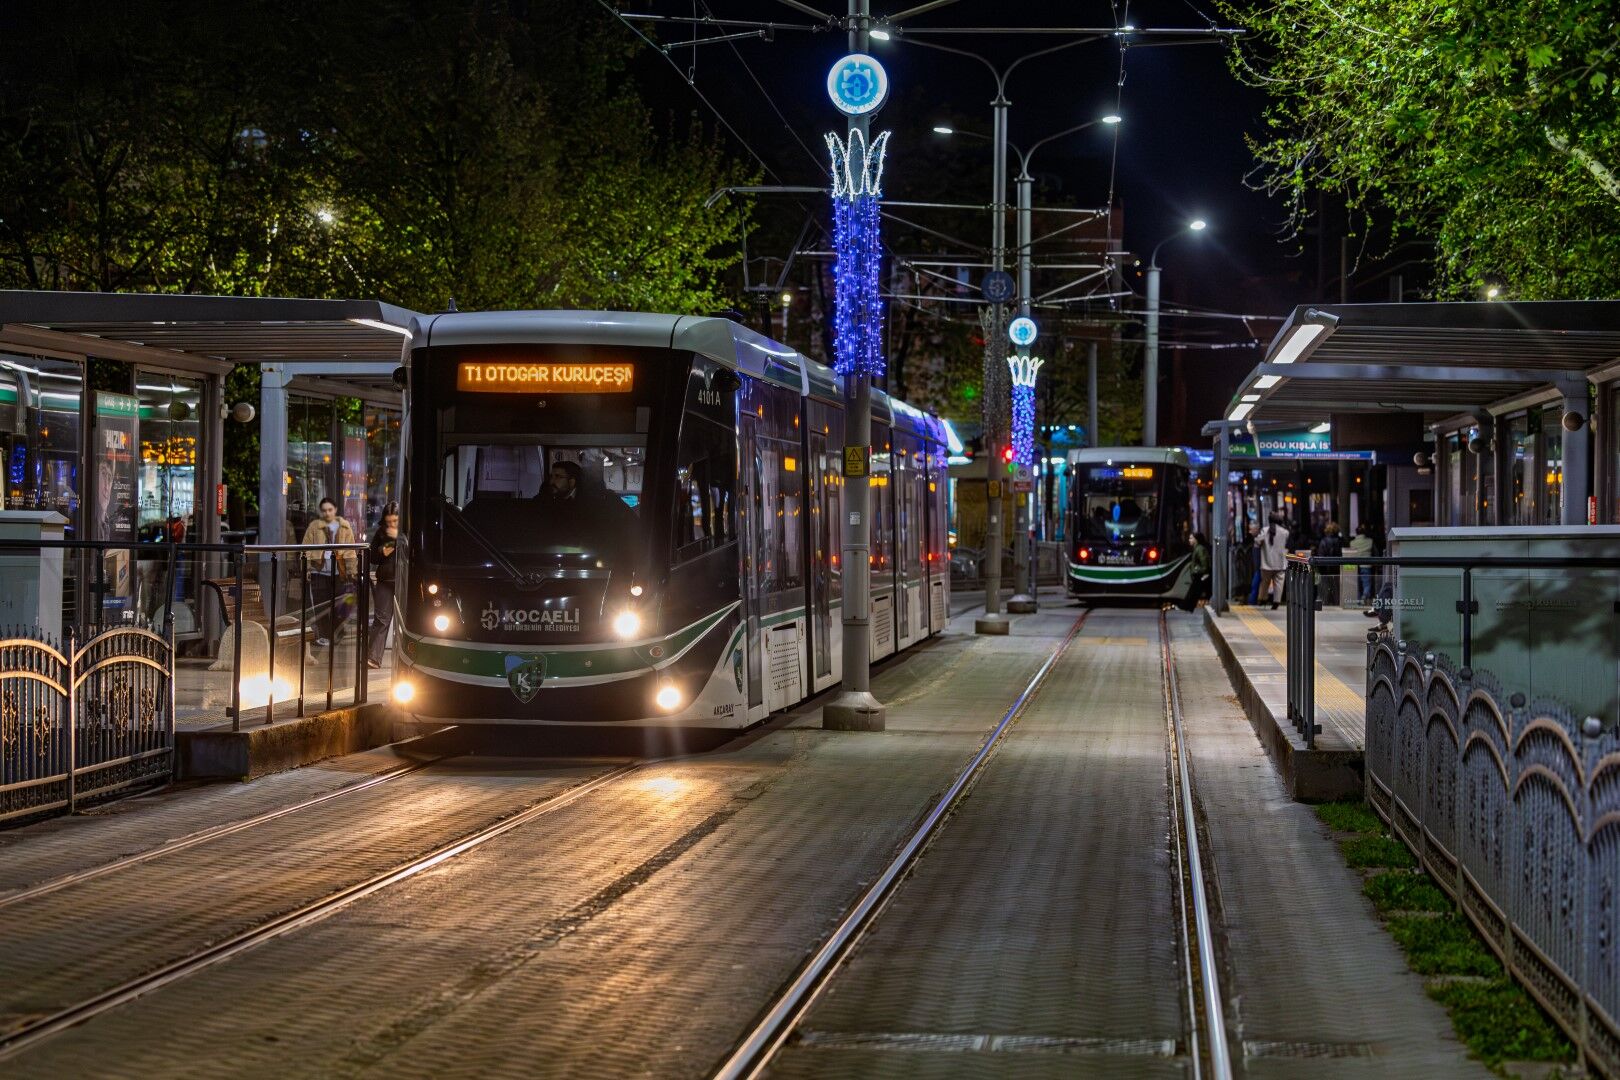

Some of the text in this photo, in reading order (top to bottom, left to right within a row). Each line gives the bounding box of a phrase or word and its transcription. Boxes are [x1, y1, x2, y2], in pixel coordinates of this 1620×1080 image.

[465, 366, 482, 382] T1
[485, 366, 549, 382] OTOGAR
[1259, 441, 1331, 451] DOĞU KIŞLA İS
[504, 608, 580, 623] KOCAELİ
